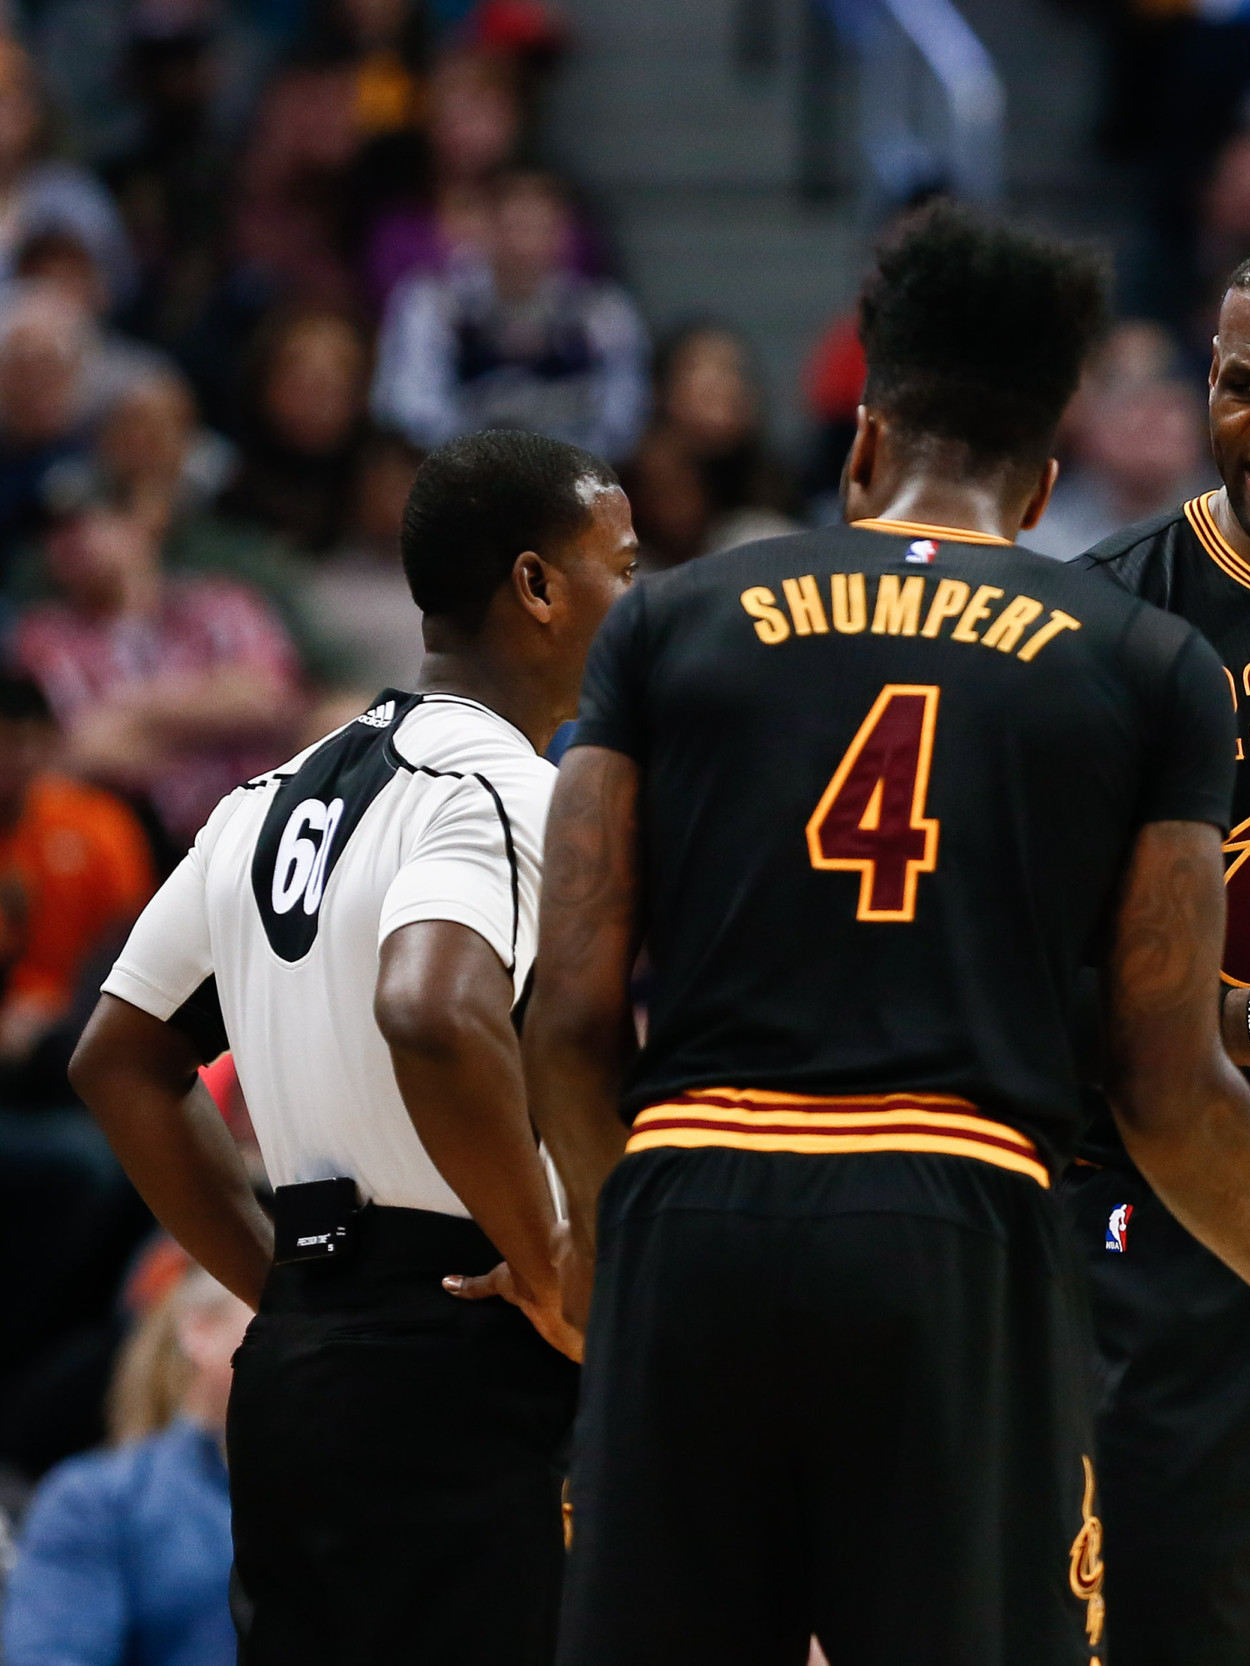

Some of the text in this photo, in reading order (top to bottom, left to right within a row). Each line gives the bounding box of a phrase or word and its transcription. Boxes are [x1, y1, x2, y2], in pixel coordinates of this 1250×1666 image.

[740, 572, 1082, 663] SHUMPERT
[805, 684, 940, 921] 4
[271, 797, 345, 915] 60
[327, 1243, 335, 1252] 5
[1105, 1241, 1120, 1250] NBA
